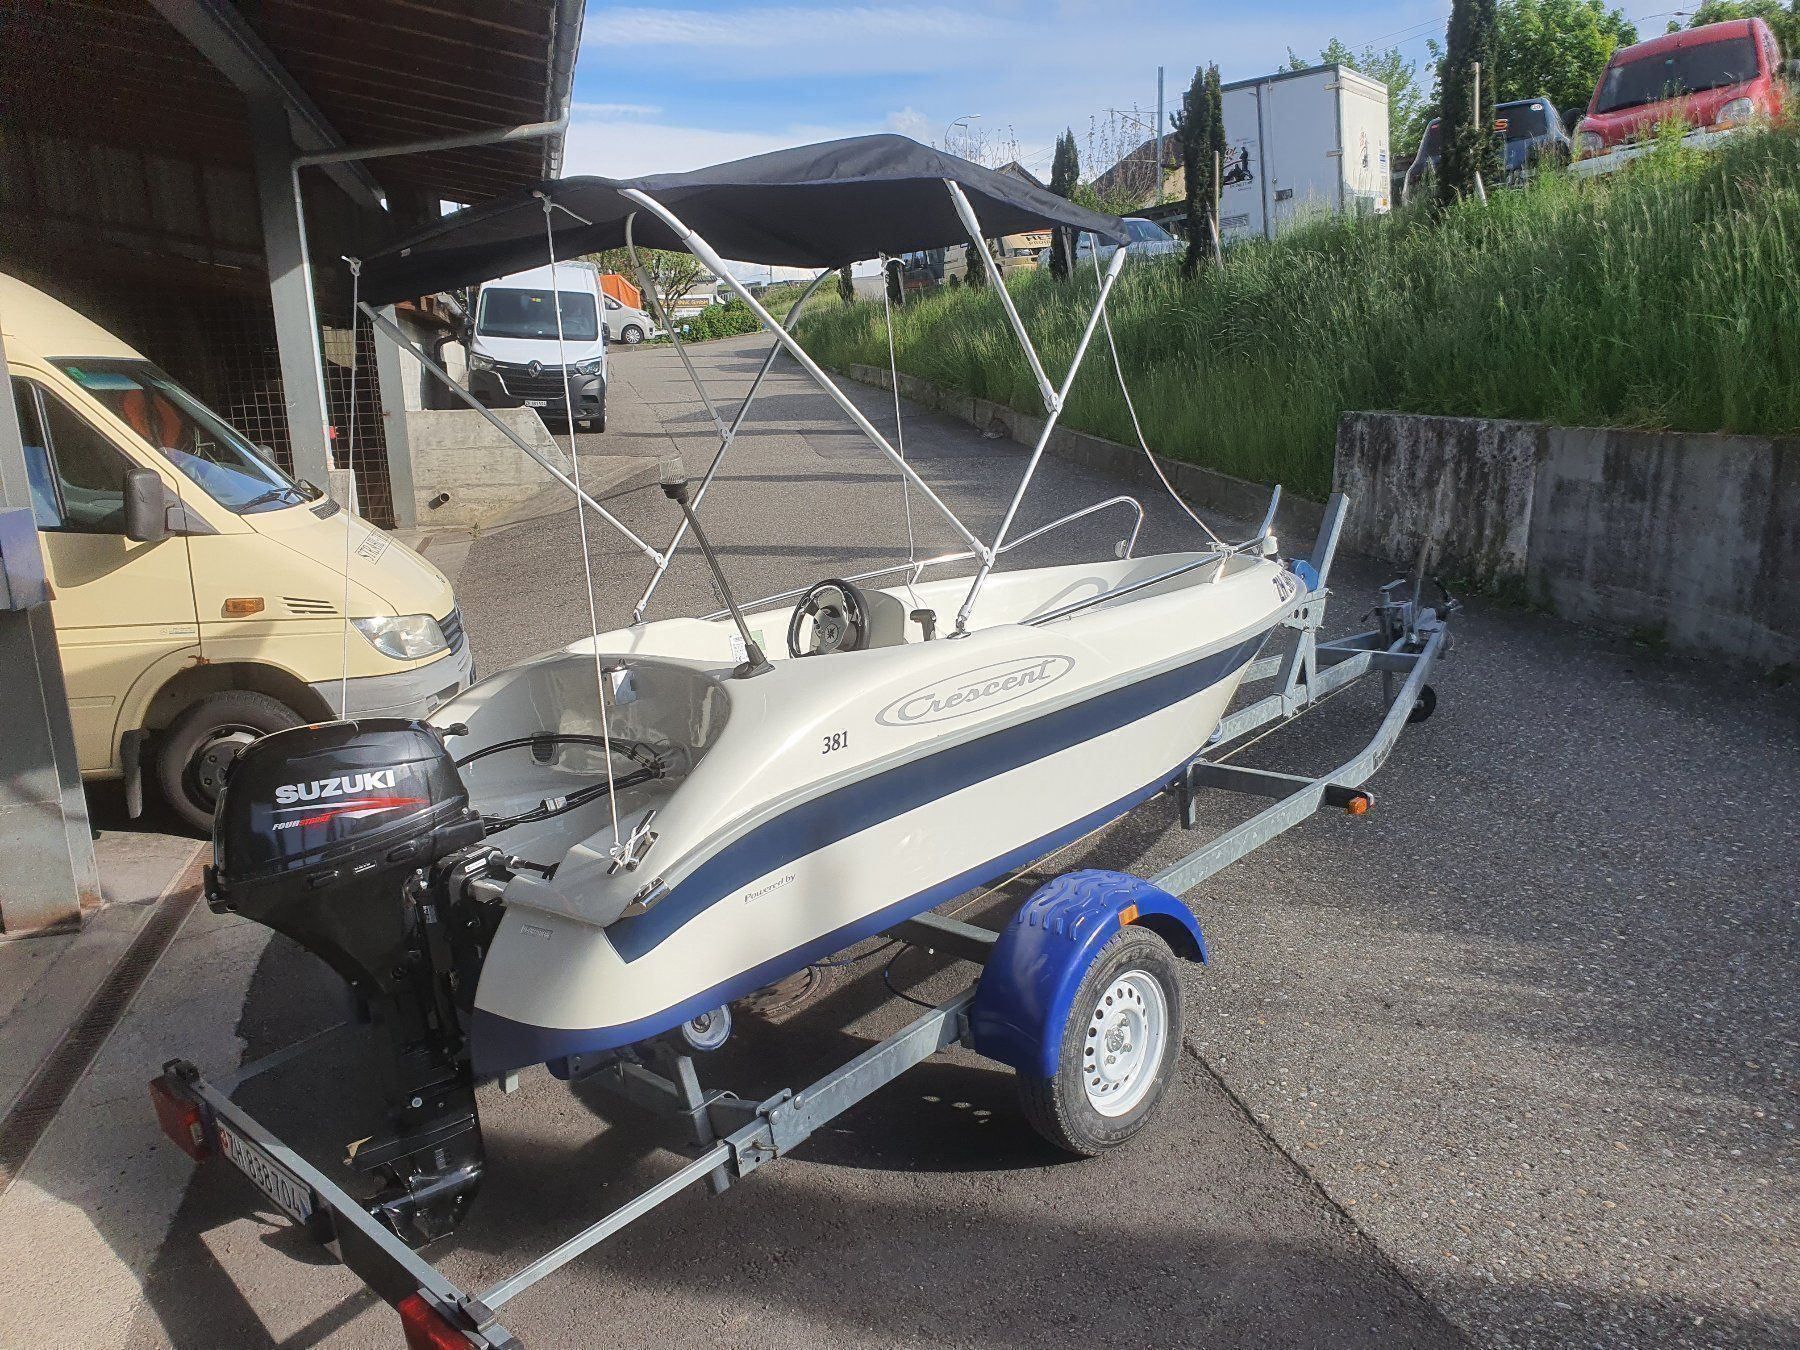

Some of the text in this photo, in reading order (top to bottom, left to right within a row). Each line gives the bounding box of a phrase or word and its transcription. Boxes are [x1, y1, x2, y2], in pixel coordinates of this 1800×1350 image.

[898, 658, 1057, 721] Crescent
[821, 731, 848, 754] 381
[274, 769, 396, 805] SUZUKI
[744, 873, 797, 903] Powered by
